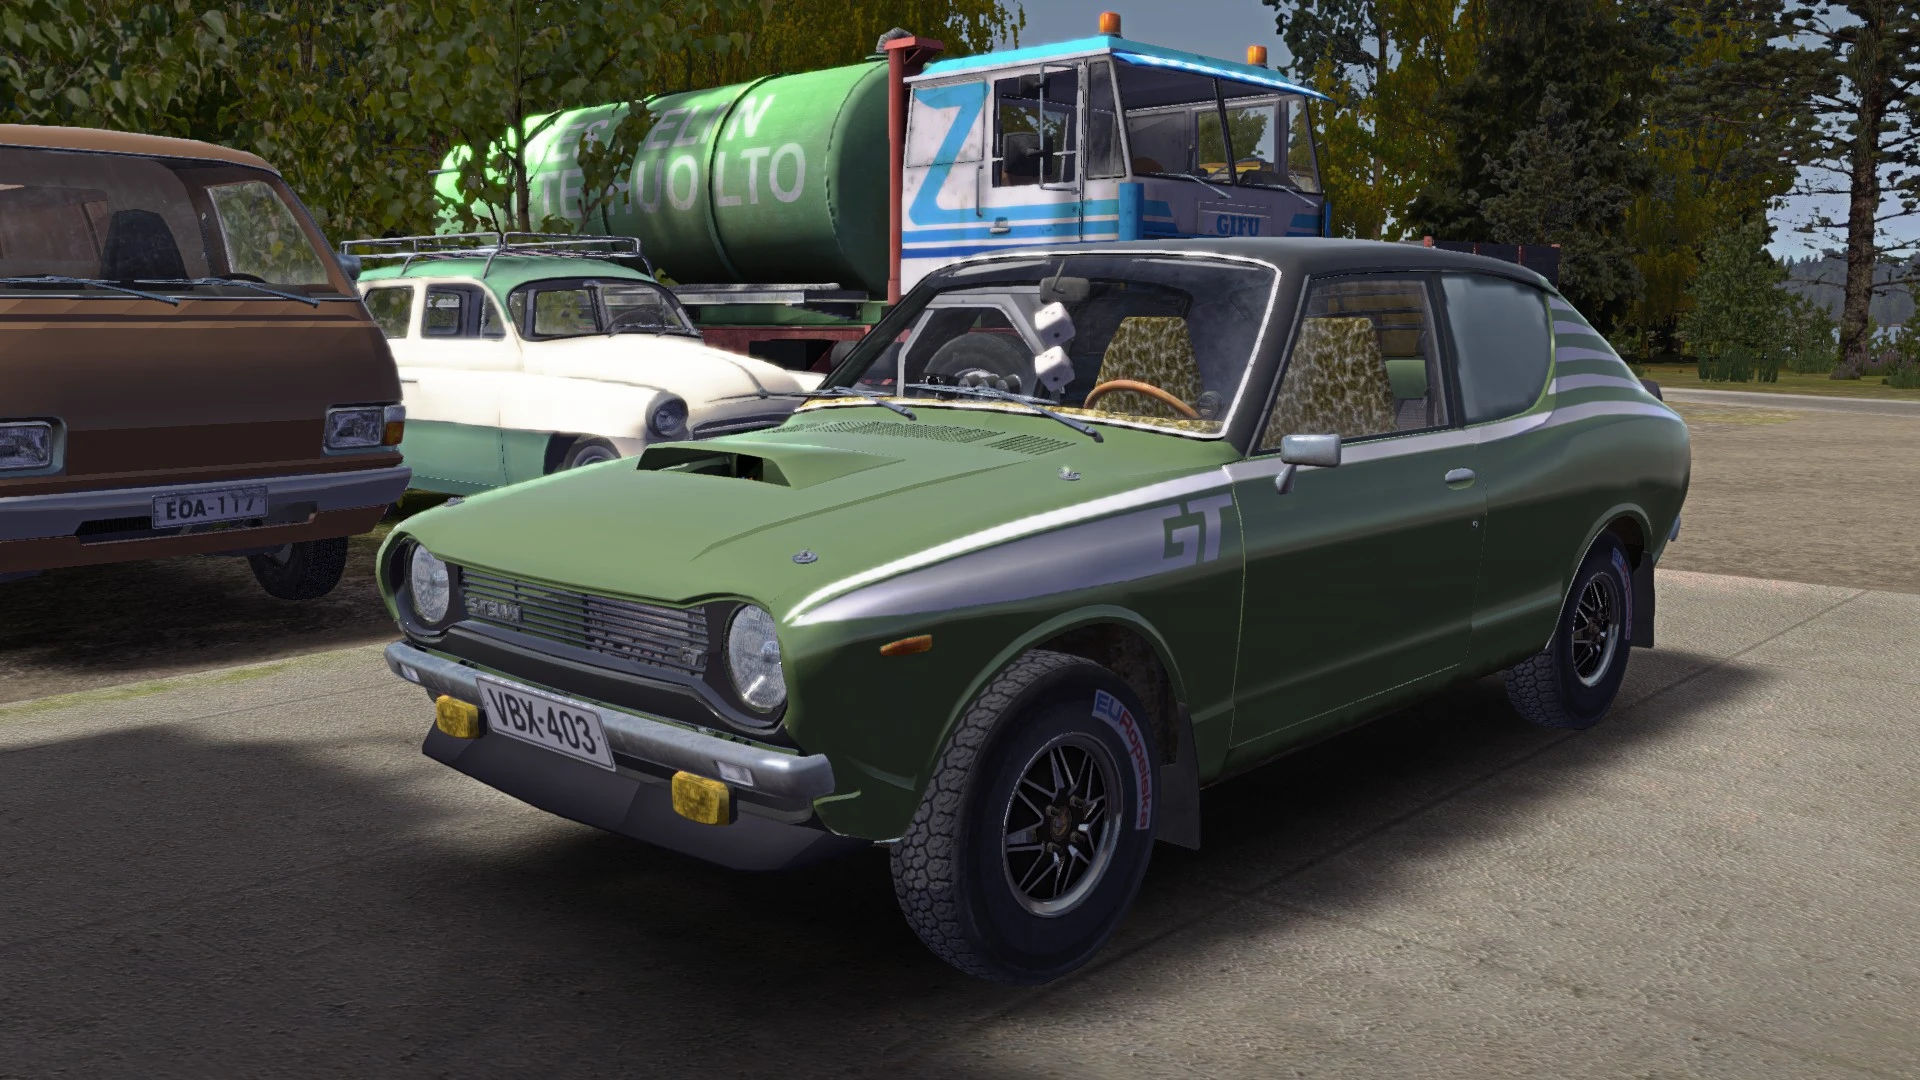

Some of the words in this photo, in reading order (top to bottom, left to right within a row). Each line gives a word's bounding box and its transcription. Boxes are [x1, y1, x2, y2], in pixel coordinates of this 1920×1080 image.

[1216, 213, 1260, 236] GIFU
[166, 493, 255, 520] EOA-117
[1162, 493, 1233, 563] GT
[487, 688, 597, 755] VBX-403
